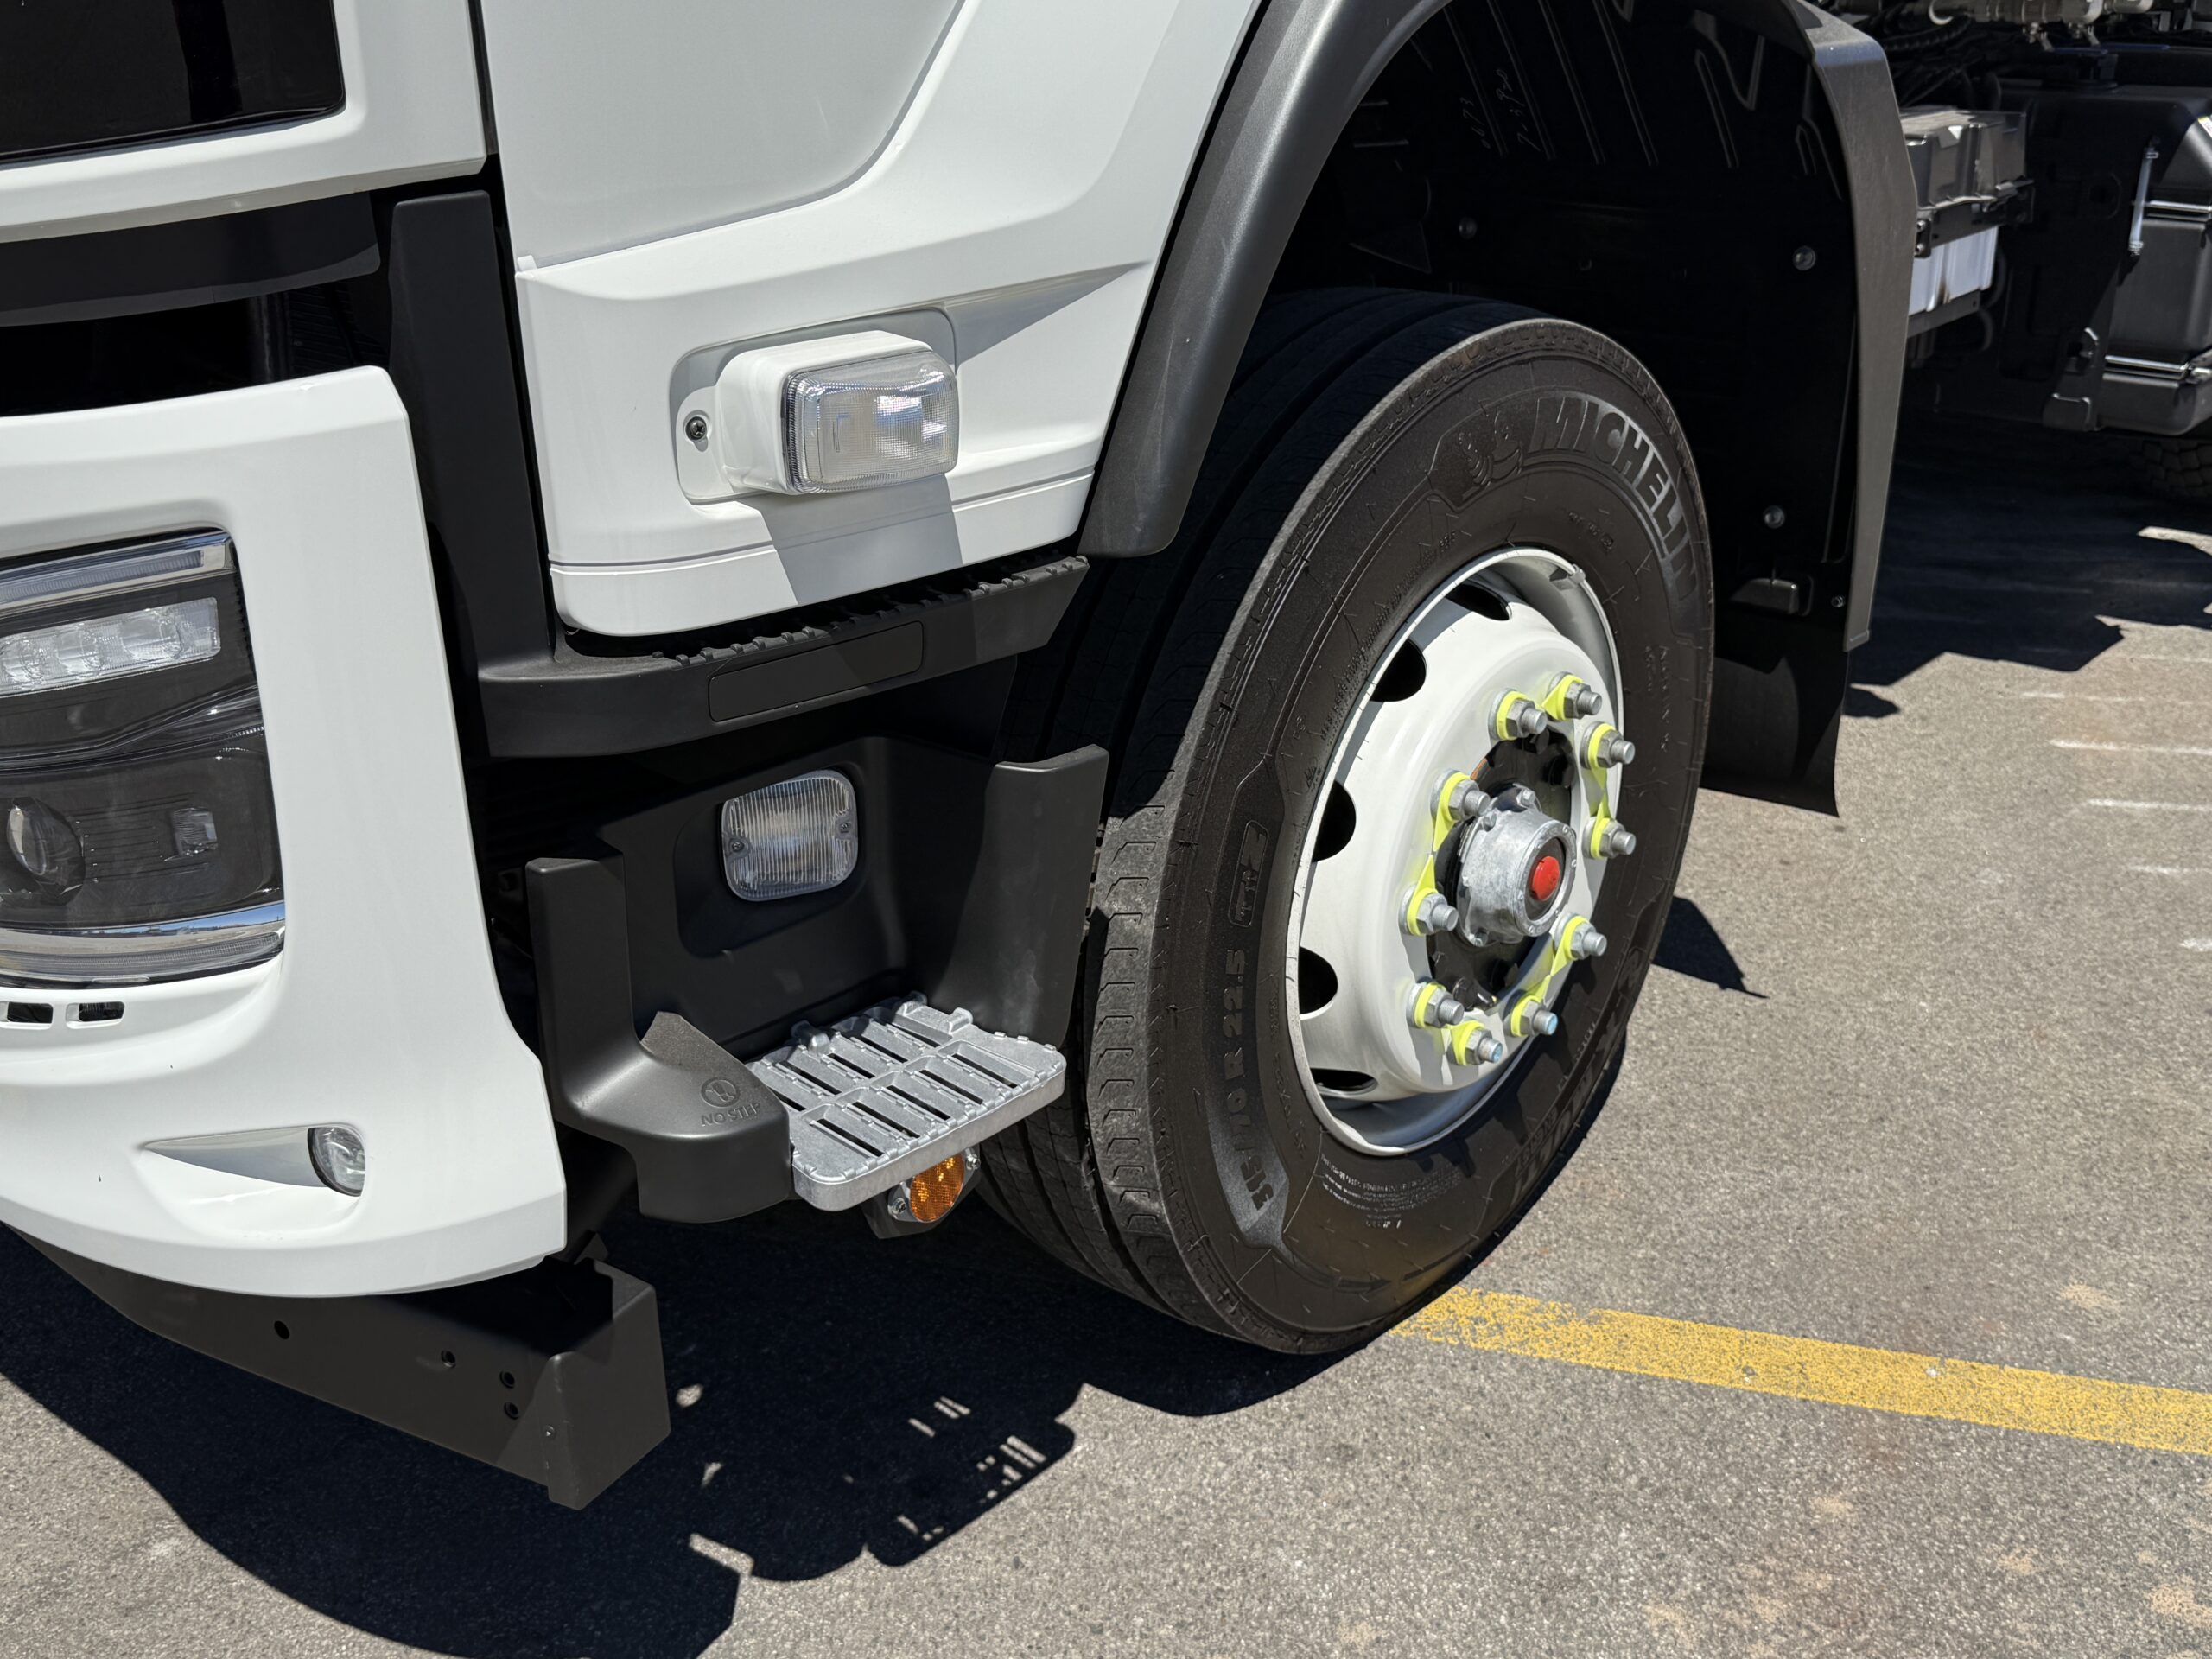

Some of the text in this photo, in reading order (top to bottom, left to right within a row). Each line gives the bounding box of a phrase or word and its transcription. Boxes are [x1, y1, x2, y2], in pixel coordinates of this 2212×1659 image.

[1528, 397, 1699, 602] MICHELIN
[1223, 949, 1245, 1037] 22.5
[701, 1102, 761, 1128] NO STEP
